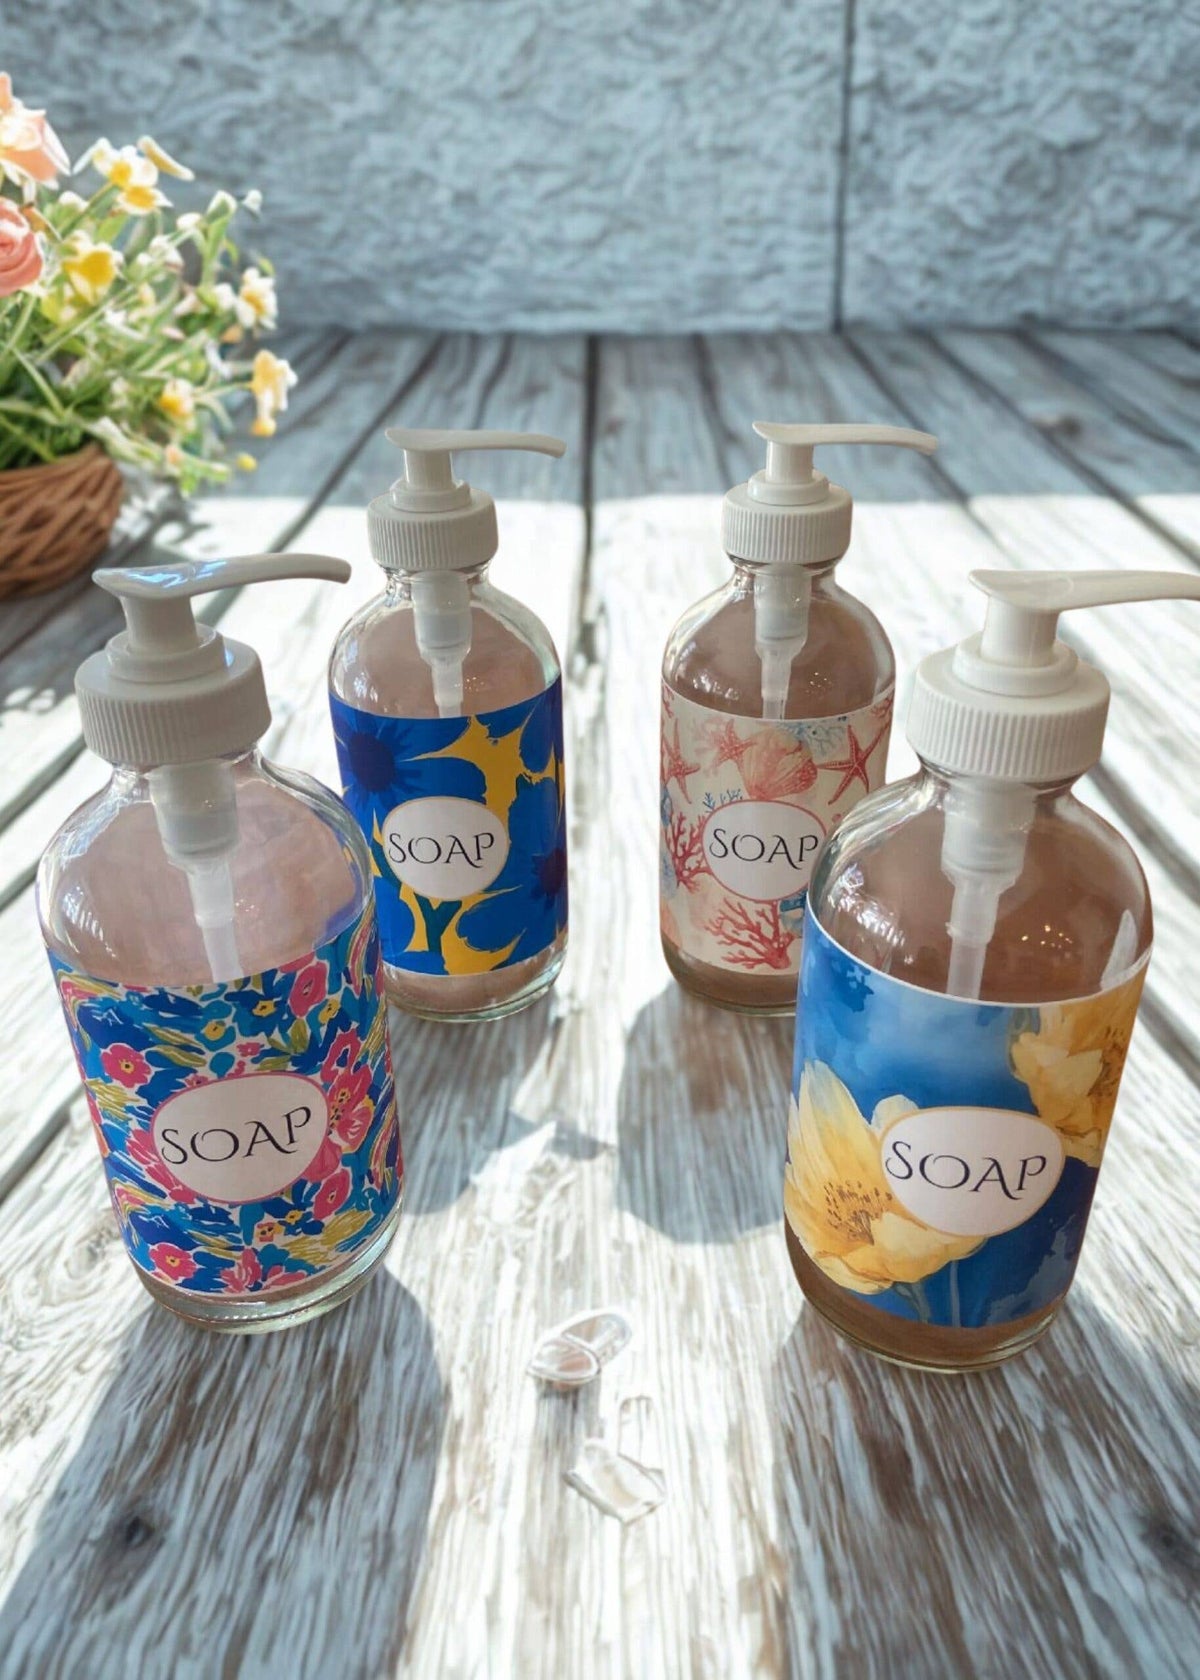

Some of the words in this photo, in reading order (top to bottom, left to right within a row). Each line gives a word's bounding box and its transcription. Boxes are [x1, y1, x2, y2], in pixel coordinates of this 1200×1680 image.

[388, 832, 495, 869] SOAP
[708, 828, 819, 870] SOAP
[161, 1106, 312, 1165] SOAP
[885, 1140, 1047, 1200] SOAP
